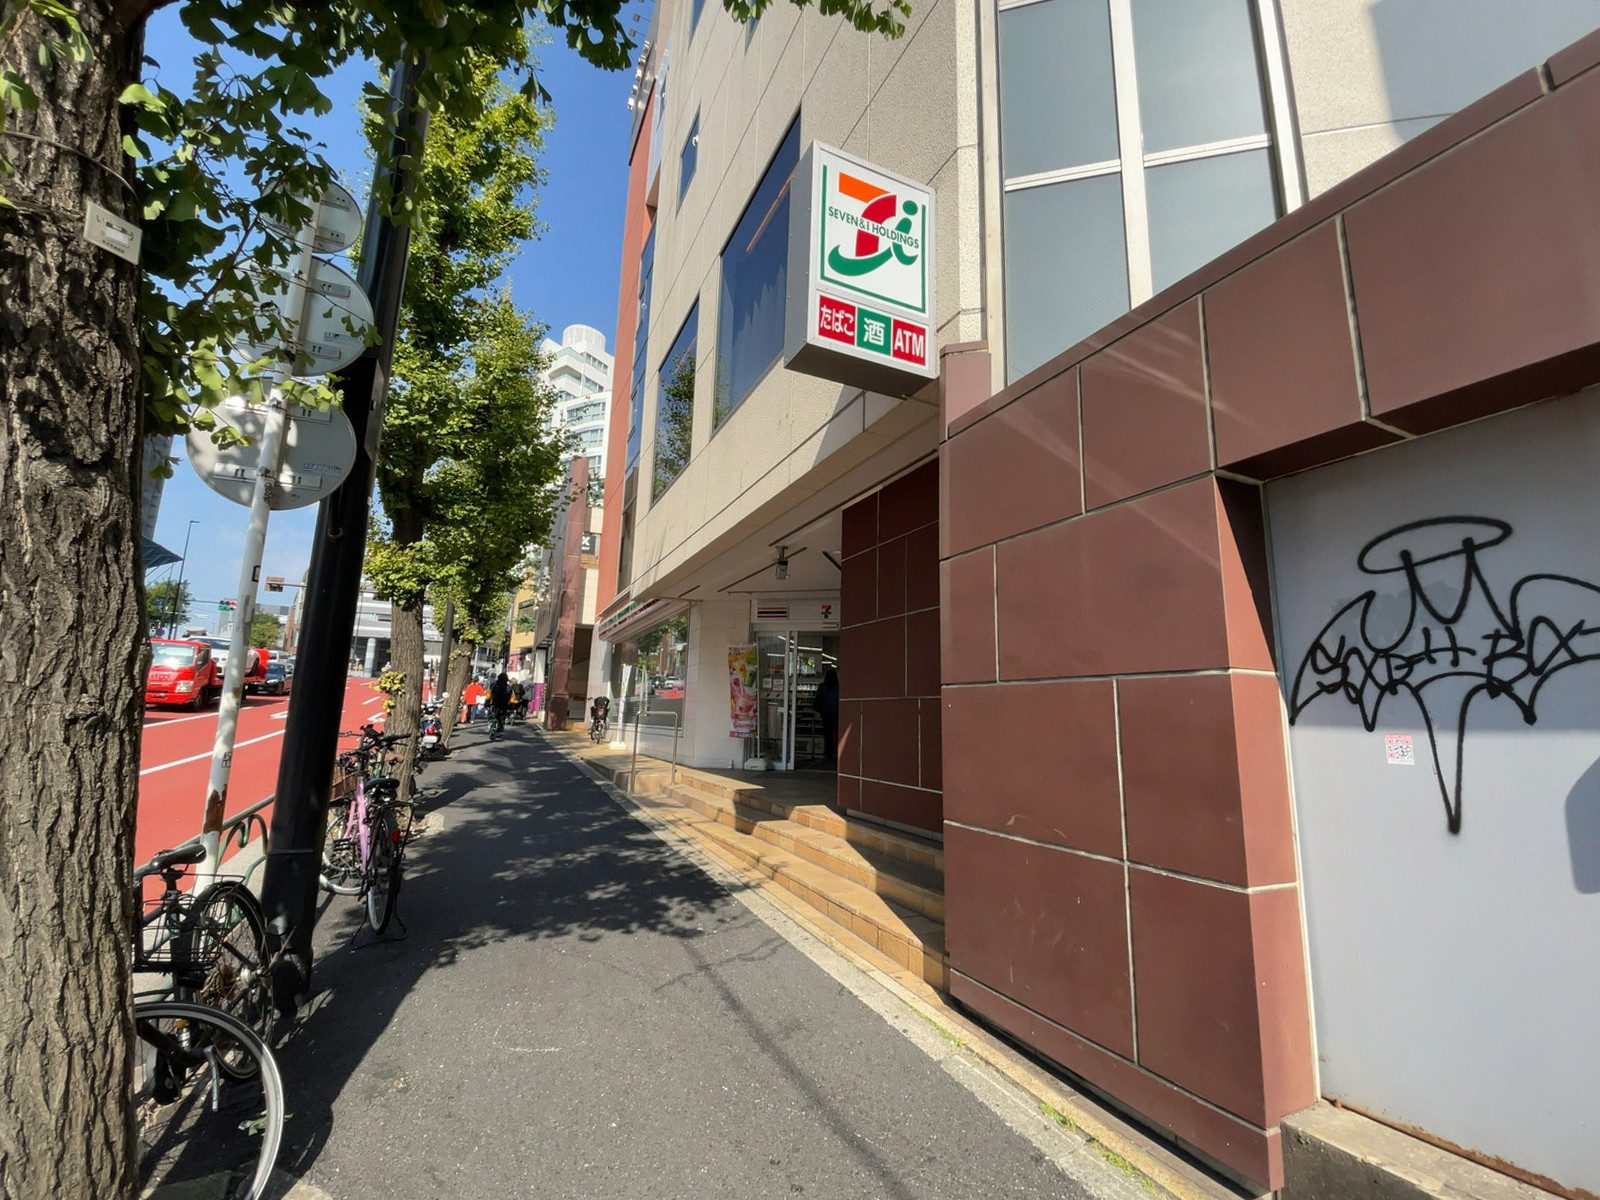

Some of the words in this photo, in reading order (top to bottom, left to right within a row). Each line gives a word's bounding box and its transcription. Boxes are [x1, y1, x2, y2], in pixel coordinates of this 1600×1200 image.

[872, 223, 920, 249] HOLDINGS
[820, 304, 855, 337] たばこ
[863, 317, 886, 346] 酒
[894, 328, 925, 358] ATM
